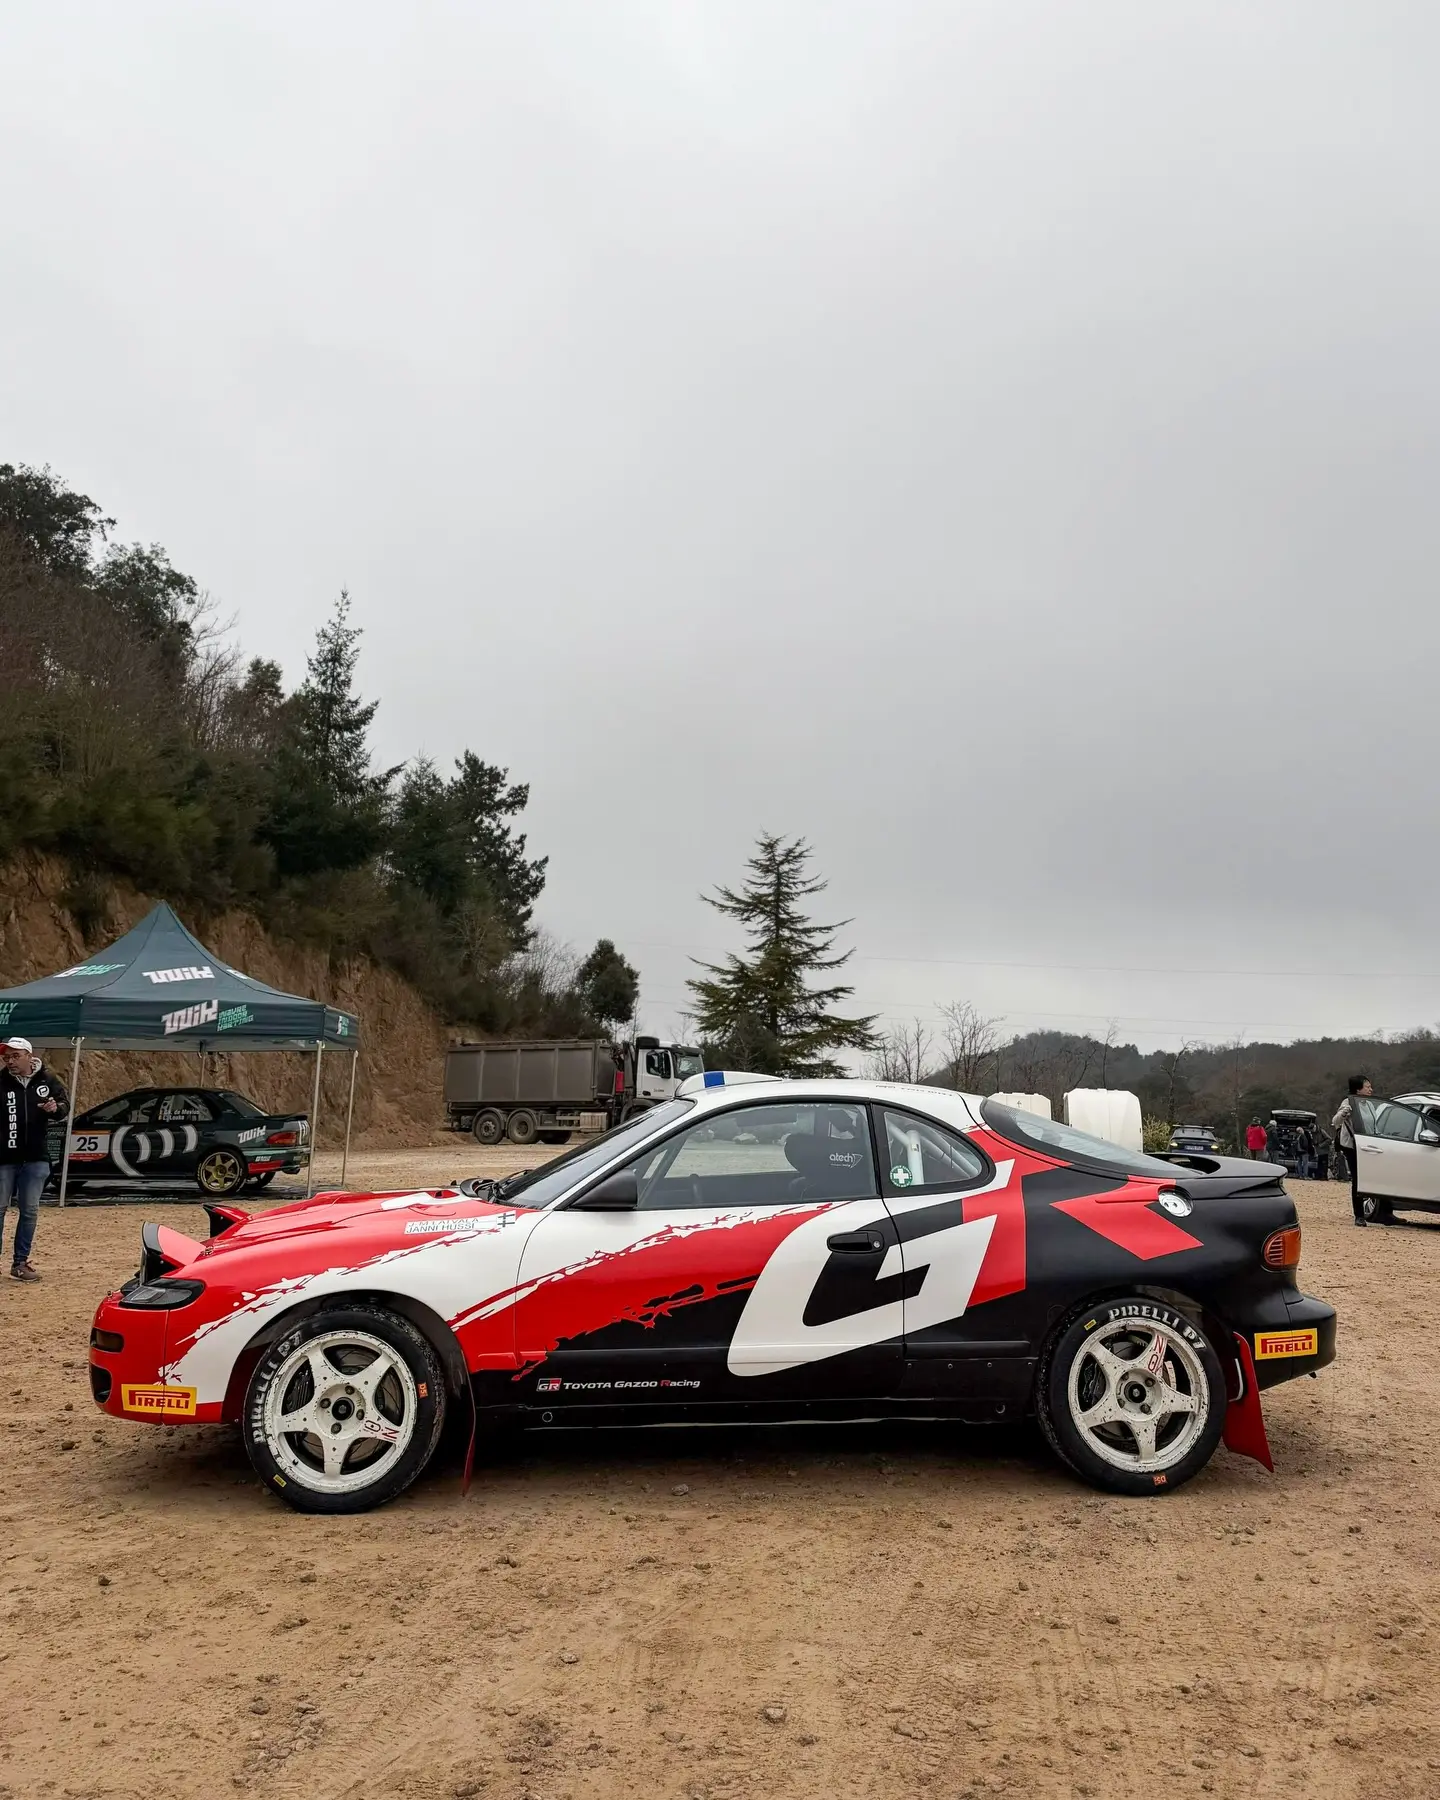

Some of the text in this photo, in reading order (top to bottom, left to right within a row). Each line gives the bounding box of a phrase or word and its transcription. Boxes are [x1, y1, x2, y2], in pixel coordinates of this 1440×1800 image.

[76, 1136, 99, 1151] 25
[1108, 1305, 1180, 1329] PIRELLI
[1261, 1334, 1313, 1354] PIRELLI
[563, 1382, 612, 1390] TOYOTA
[614, 1380, 658, 1388] GAZOO
[660, 1379, 701, 1389] Racing
[128, 1389, 191, 1410] PIRELLI
[250, 1359, 280, 1445] PIRELLI
